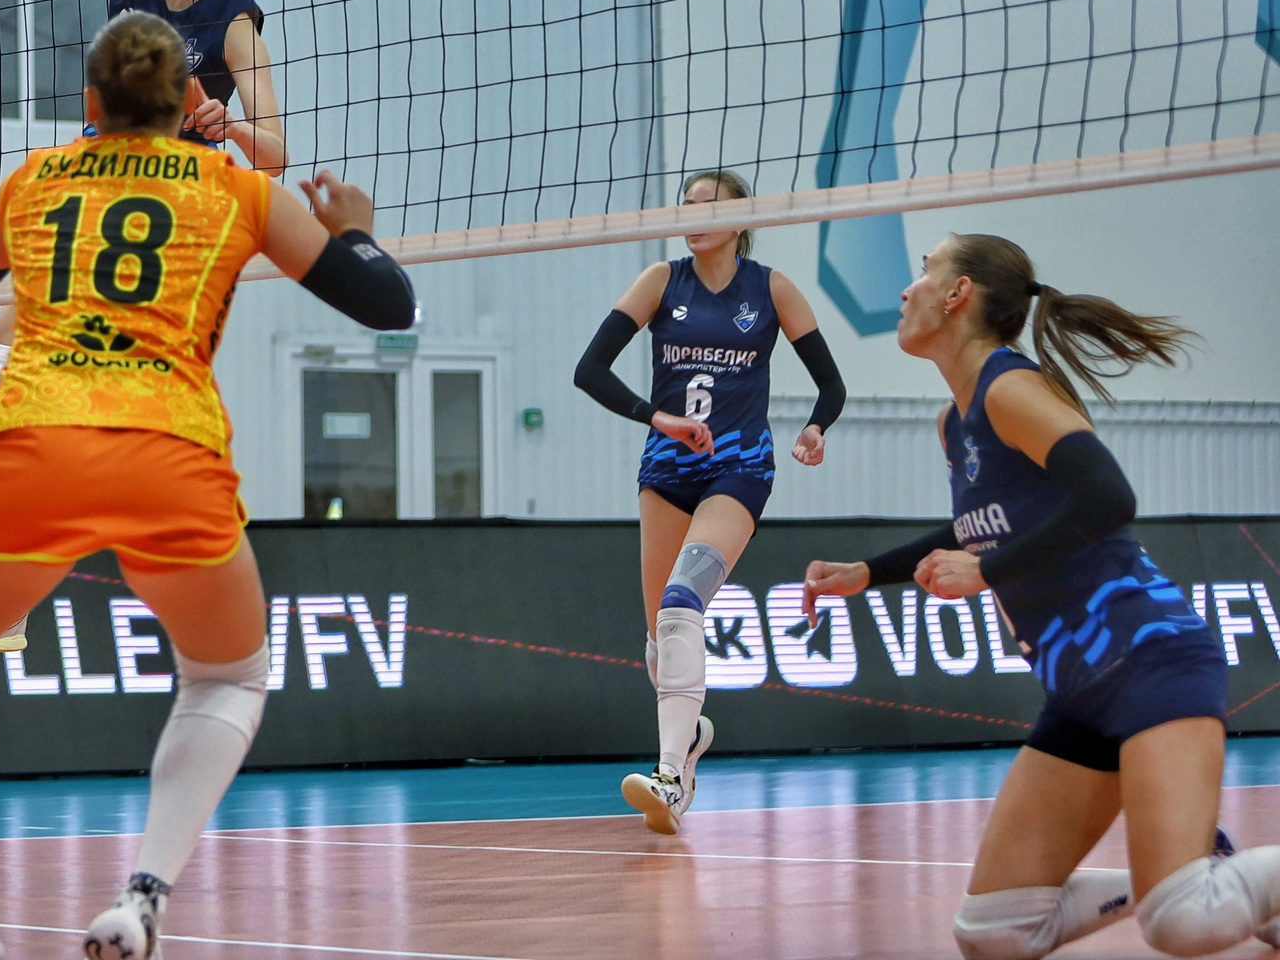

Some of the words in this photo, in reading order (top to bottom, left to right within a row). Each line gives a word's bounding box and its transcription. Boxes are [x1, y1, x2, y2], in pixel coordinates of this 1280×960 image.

[36, 150, 200, 181] БУДИЛОВА
[42, 195, 175, 304] 18
[684, 373, 715, 423] 6
